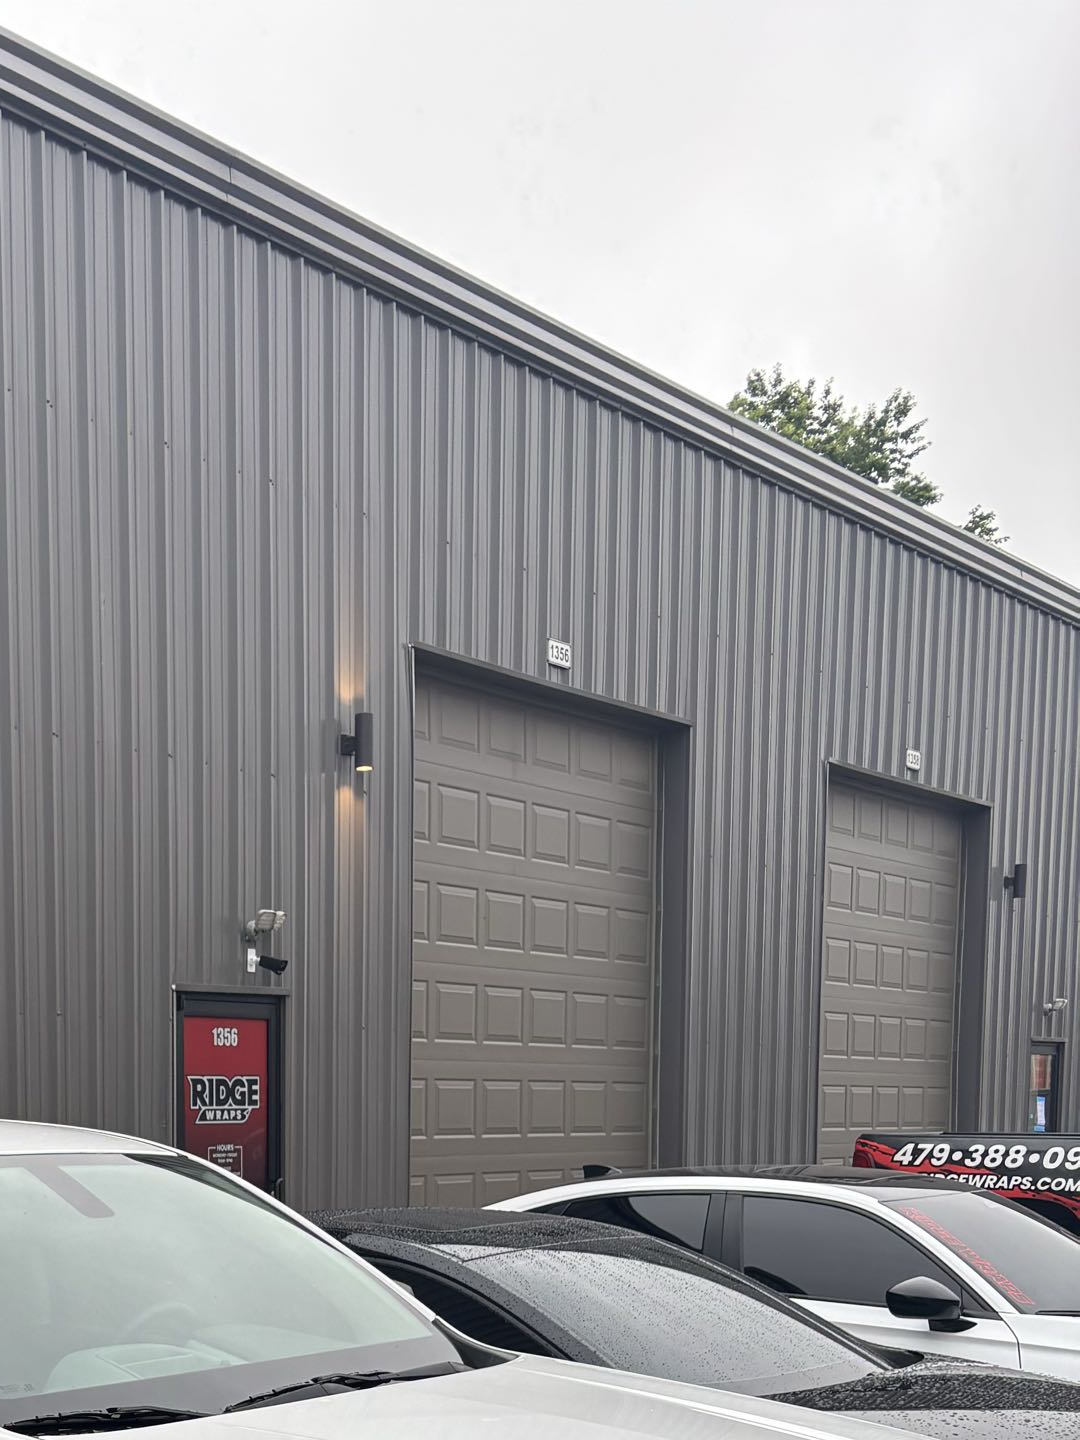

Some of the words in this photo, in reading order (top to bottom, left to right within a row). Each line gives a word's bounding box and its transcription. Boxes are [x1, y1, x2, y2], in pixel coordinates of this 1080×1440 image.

[550, 644, 570, 663] 1356
[212, 1027, 238, 1047] 1356
[187, 1075, 260, 1110] RIDGE
[205, 1110, 242, 1121] WRAPS
[216, 1144, 234, 1152] HOURS
